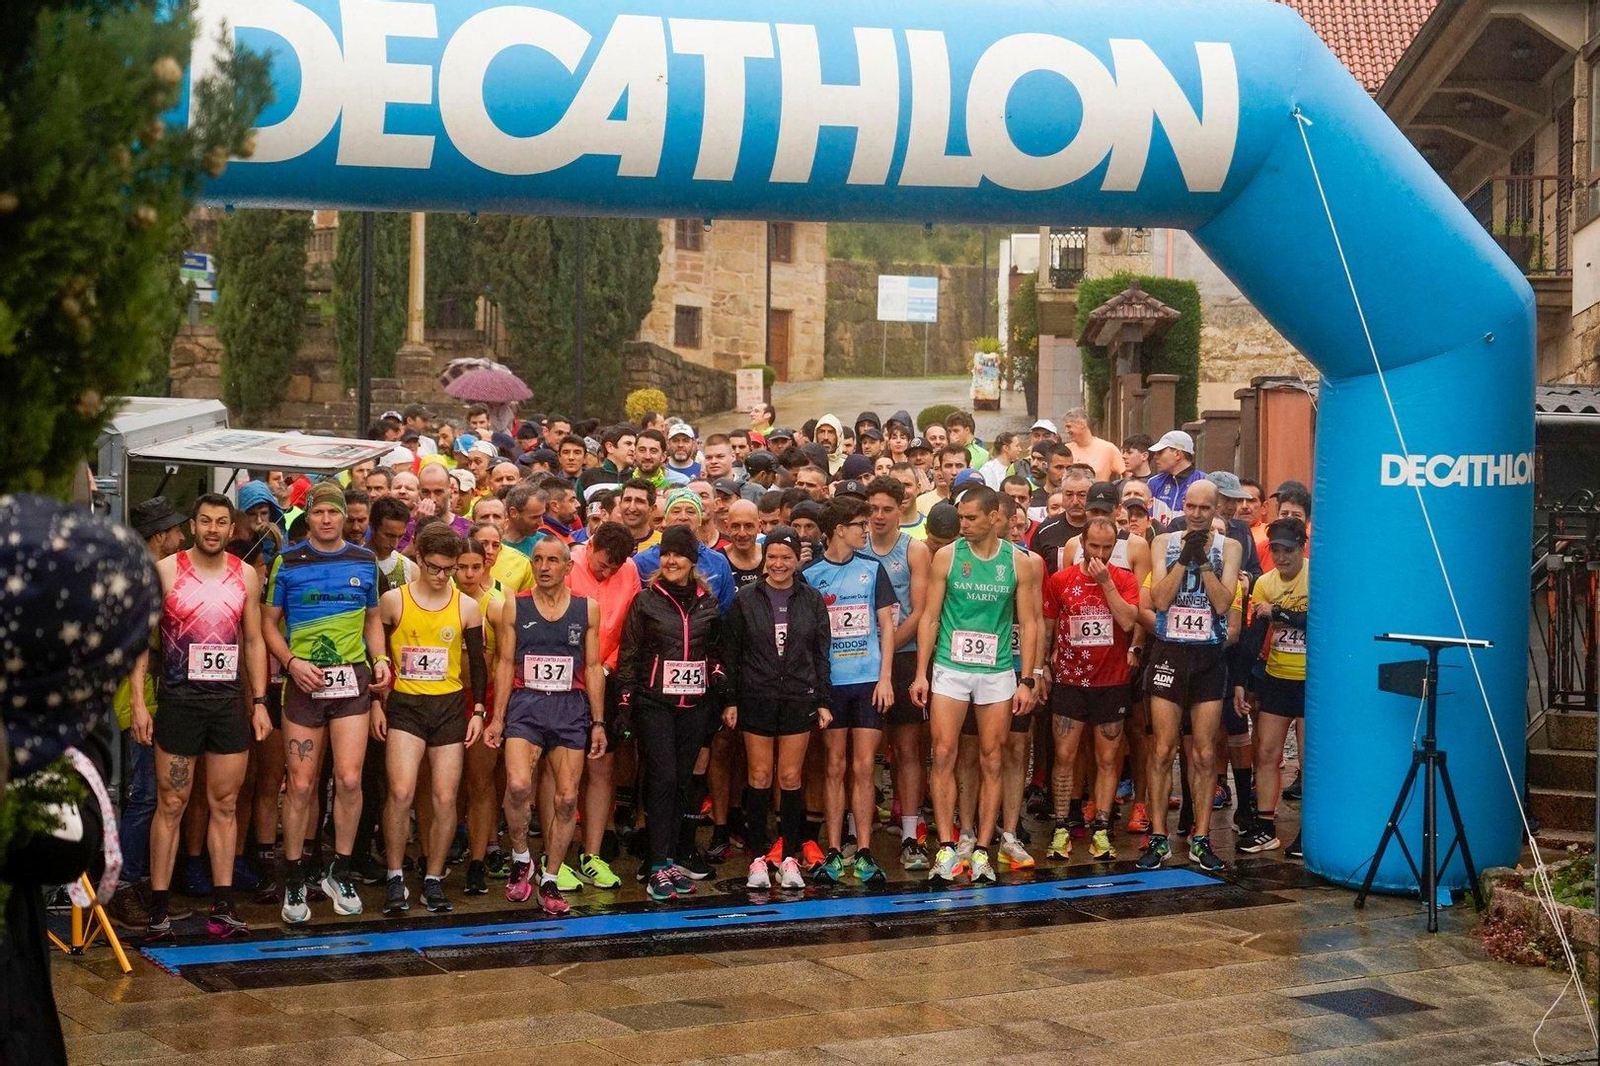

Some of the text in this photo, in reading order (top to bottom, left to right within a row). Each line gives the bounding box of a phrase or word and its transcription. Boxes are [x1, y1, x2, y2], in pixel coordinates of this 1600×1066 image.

[189, 0, 1239, 192] DECATHLON
[954, 582, 1011, 593] SAN MIGUEL
[966, 592, 998, 601] MARÍN
[843, 612, 853, 627] 2
[1174, 614, 1204, 630] 144
[1082, 621, 1102, 636] 63
[832, 640, 868, 649] RODOSA
[1279, 630, 1307, 645] 244
[964, 638, 985, 654] 39
[204, 652, 225, 669] 56
[418, 655, 429, 670] 4
[324, 670, 346, 687] 54
[532, 663, 565, 680] 137
[671, 669, 701, 684] 245
[1153, 673, 1174, 684] ADN
